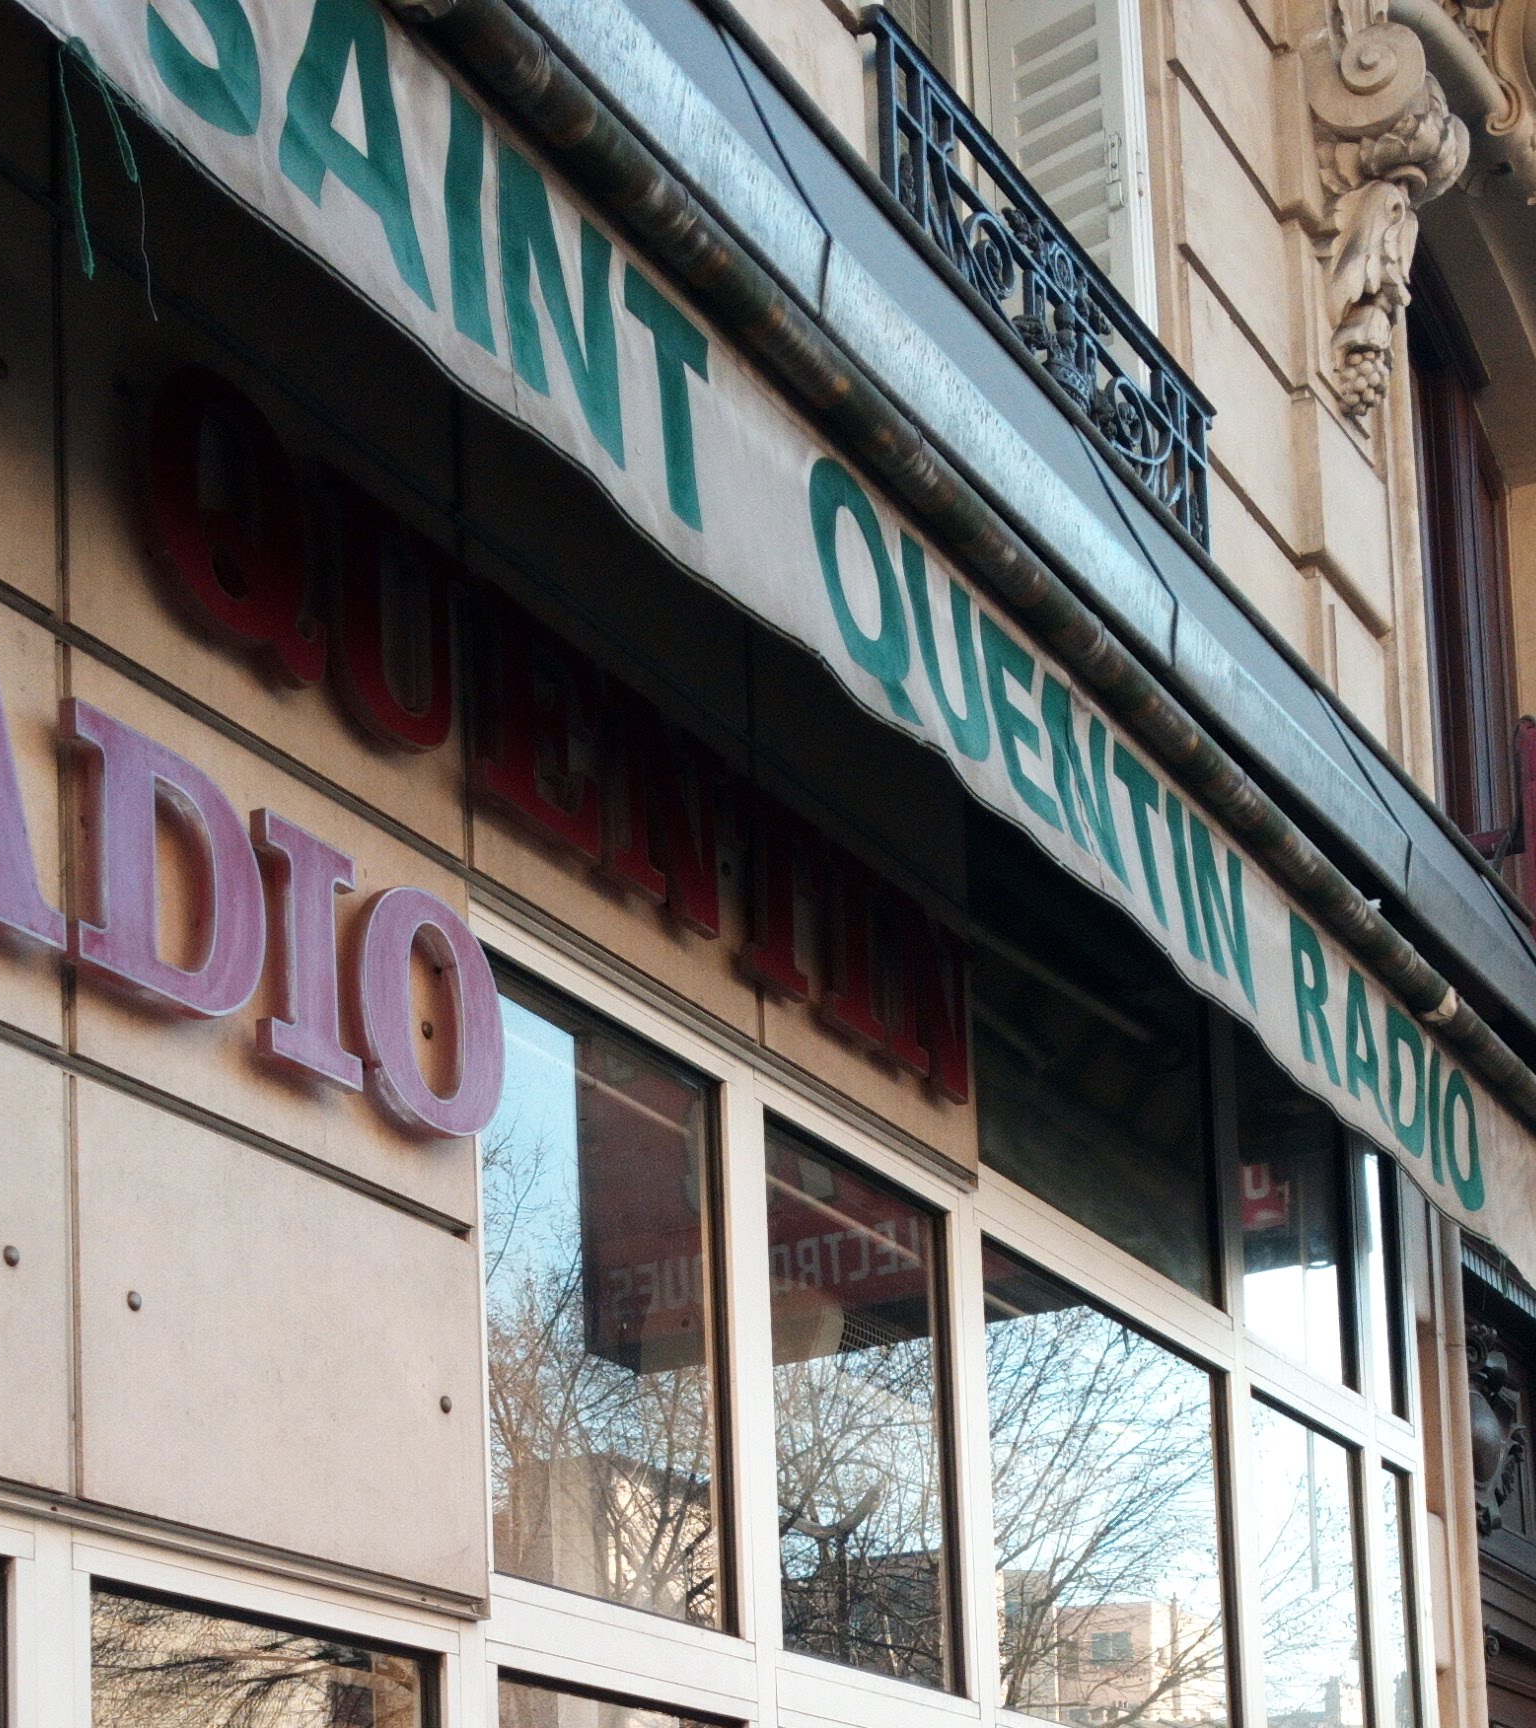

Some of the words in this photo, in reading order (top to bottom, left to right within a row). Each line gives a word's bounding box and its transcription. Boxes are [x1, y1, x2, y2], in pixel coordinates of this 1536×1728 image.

[146, 0, 710, 533] SAINT
[808, 456, 1259, 1018] QUENTIN
[1287, 903, 1485, 1215] RADIO
